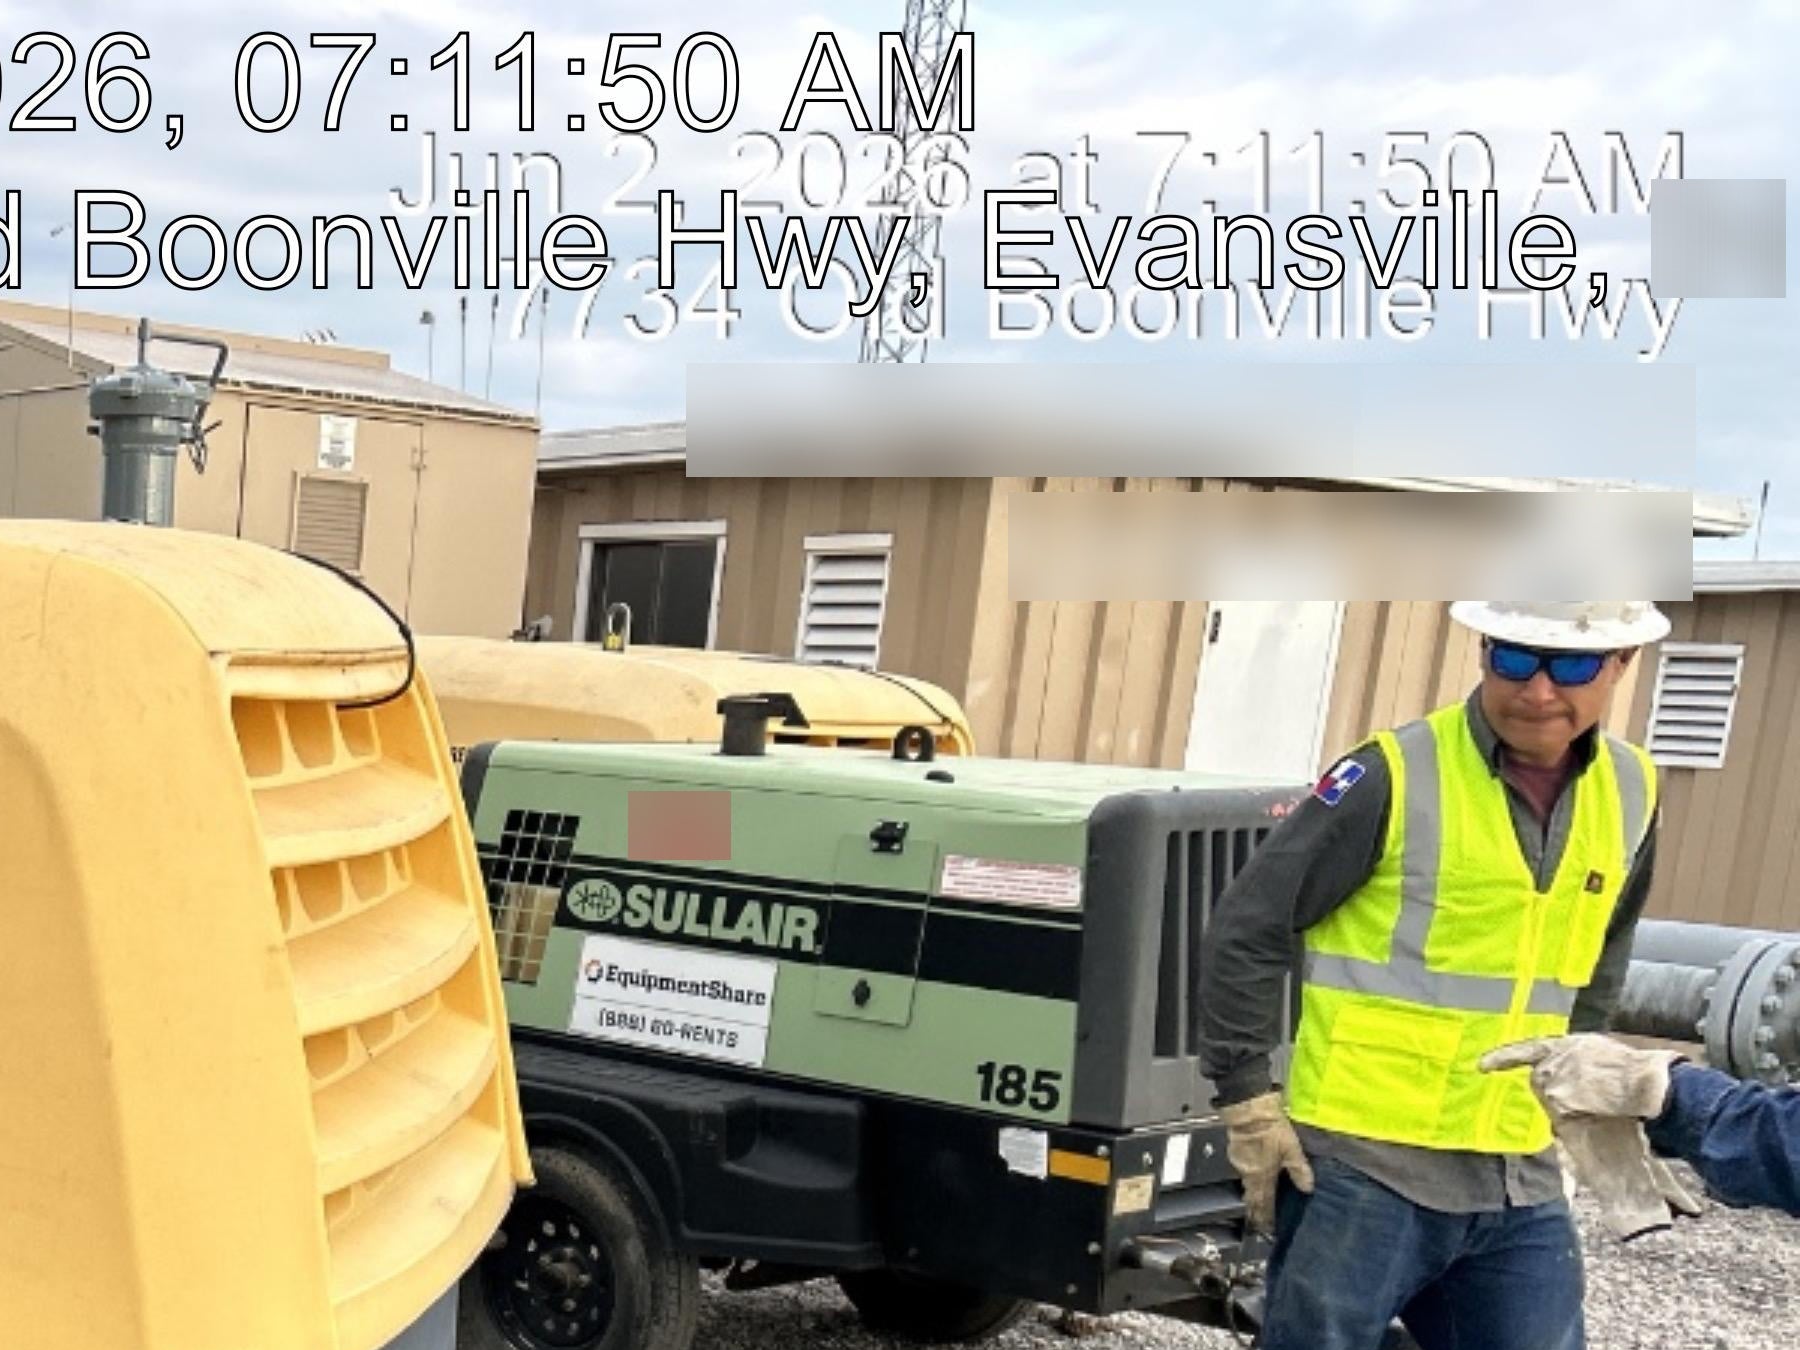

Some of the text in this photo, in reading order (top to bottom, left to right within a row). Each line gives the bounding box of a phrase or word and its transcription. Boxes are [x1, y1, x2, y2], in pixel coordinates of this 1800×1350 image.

[622, 884, 820, 952] SULLAIR
[605, 965, 767, 1006] EquipmentShare
[976, 1061, 1062, 1113] 185
